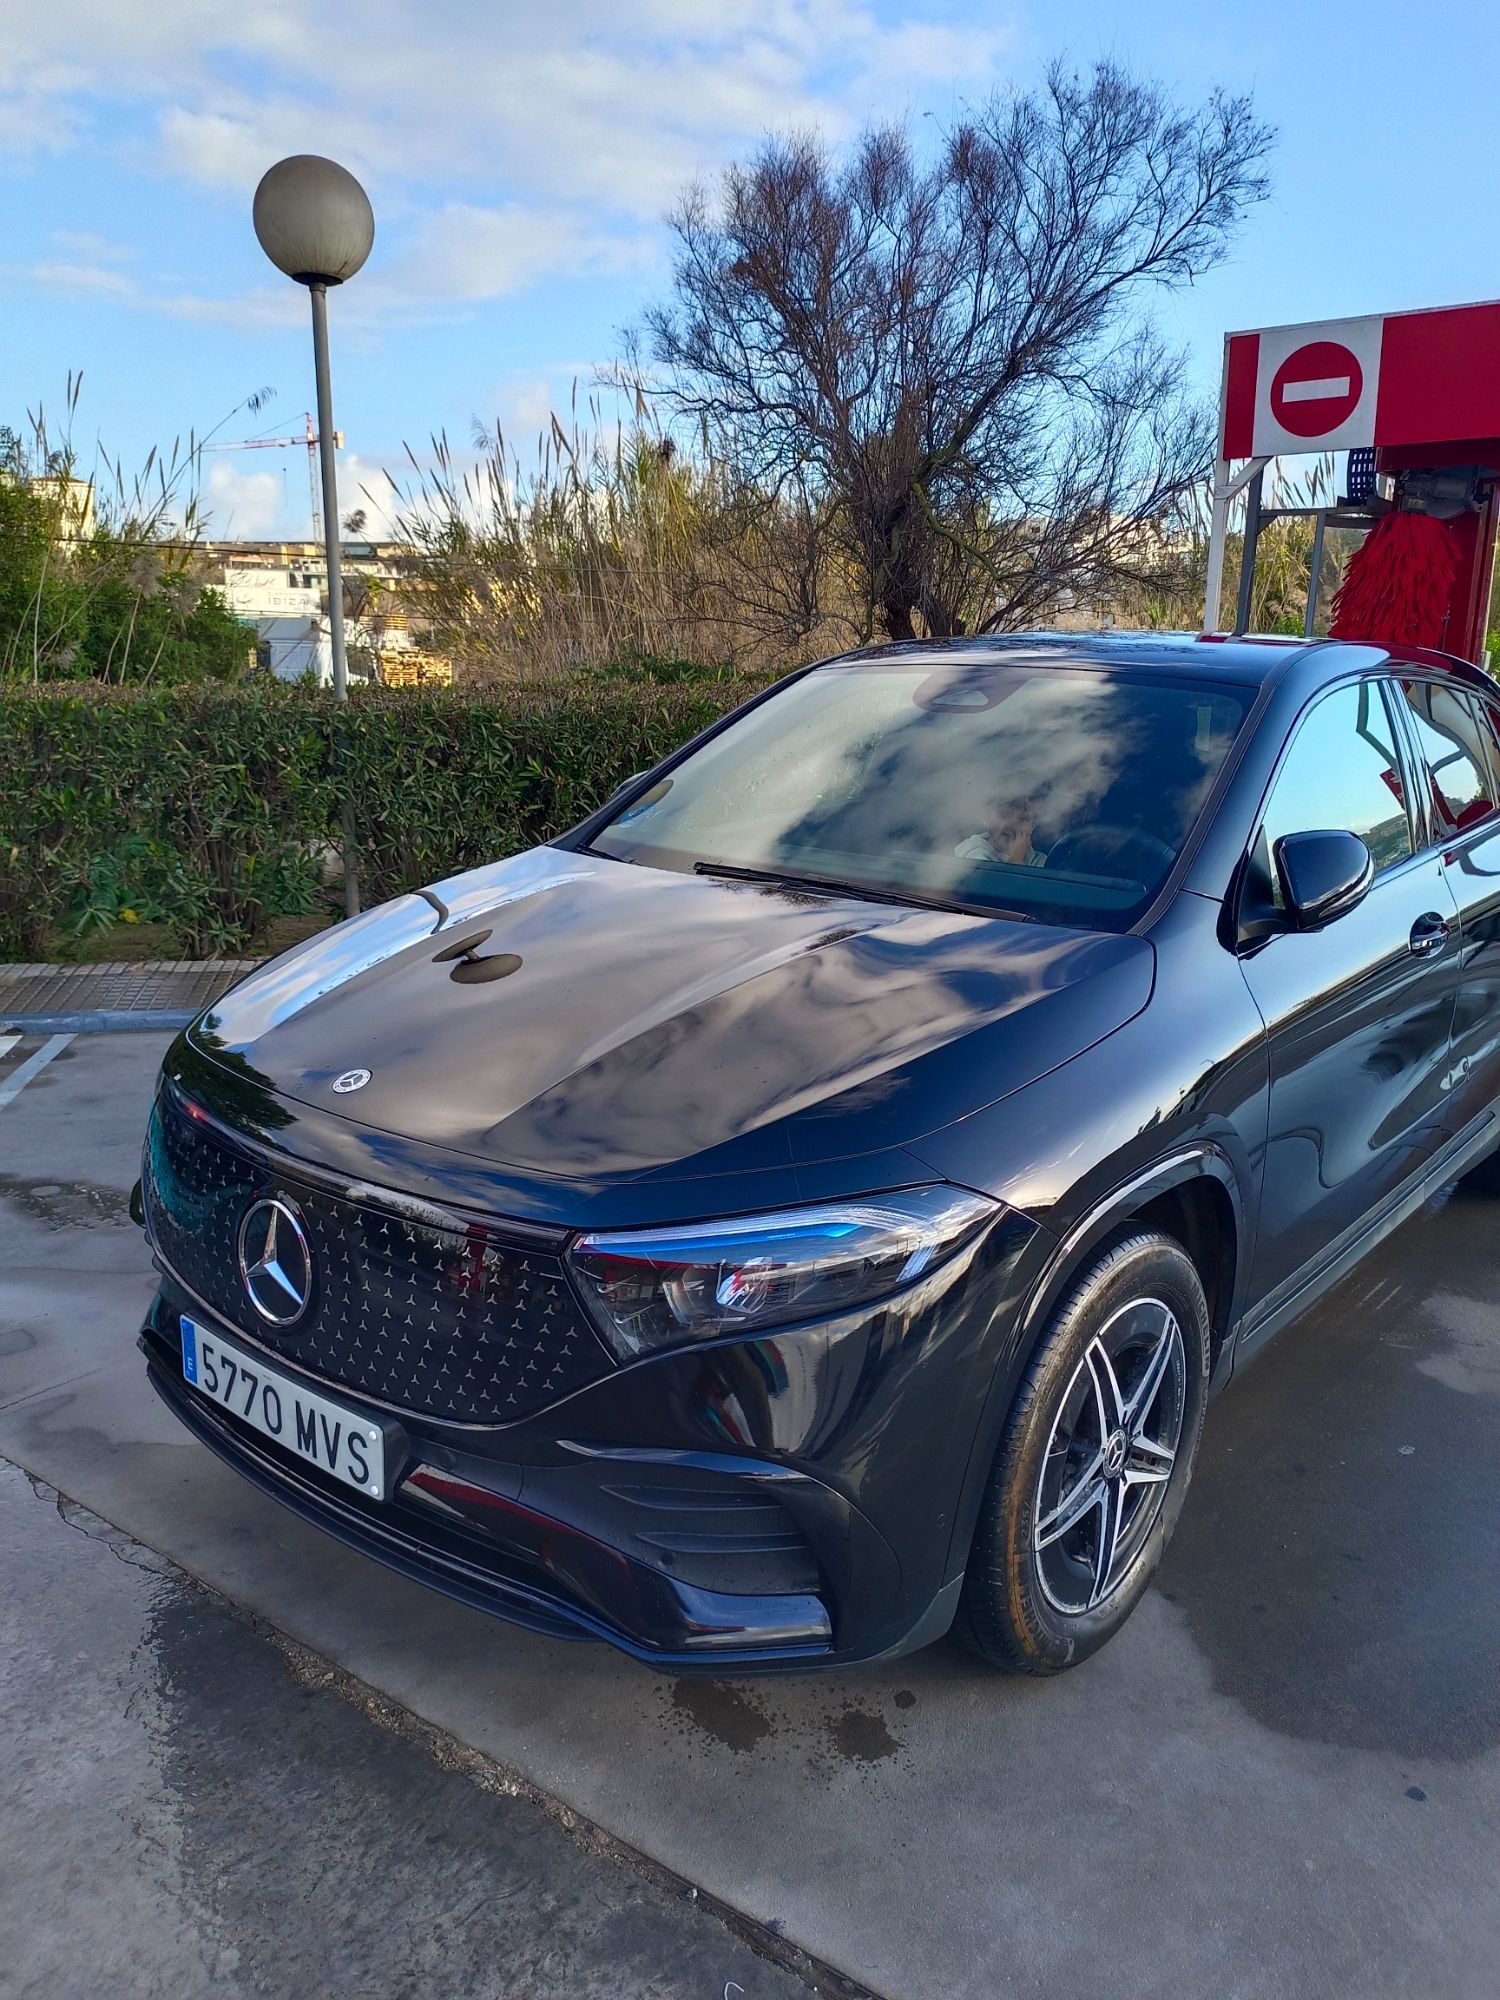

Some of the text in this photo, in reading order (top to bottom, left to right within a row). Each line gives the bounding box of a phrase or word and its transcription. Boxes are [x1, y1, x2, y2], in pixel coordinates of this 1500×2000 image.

[268, 596, 307, 607] IBIZA
[187, 1356, 194, 1372] E
[202, 1342, 370, 1485] 5770 MVS
